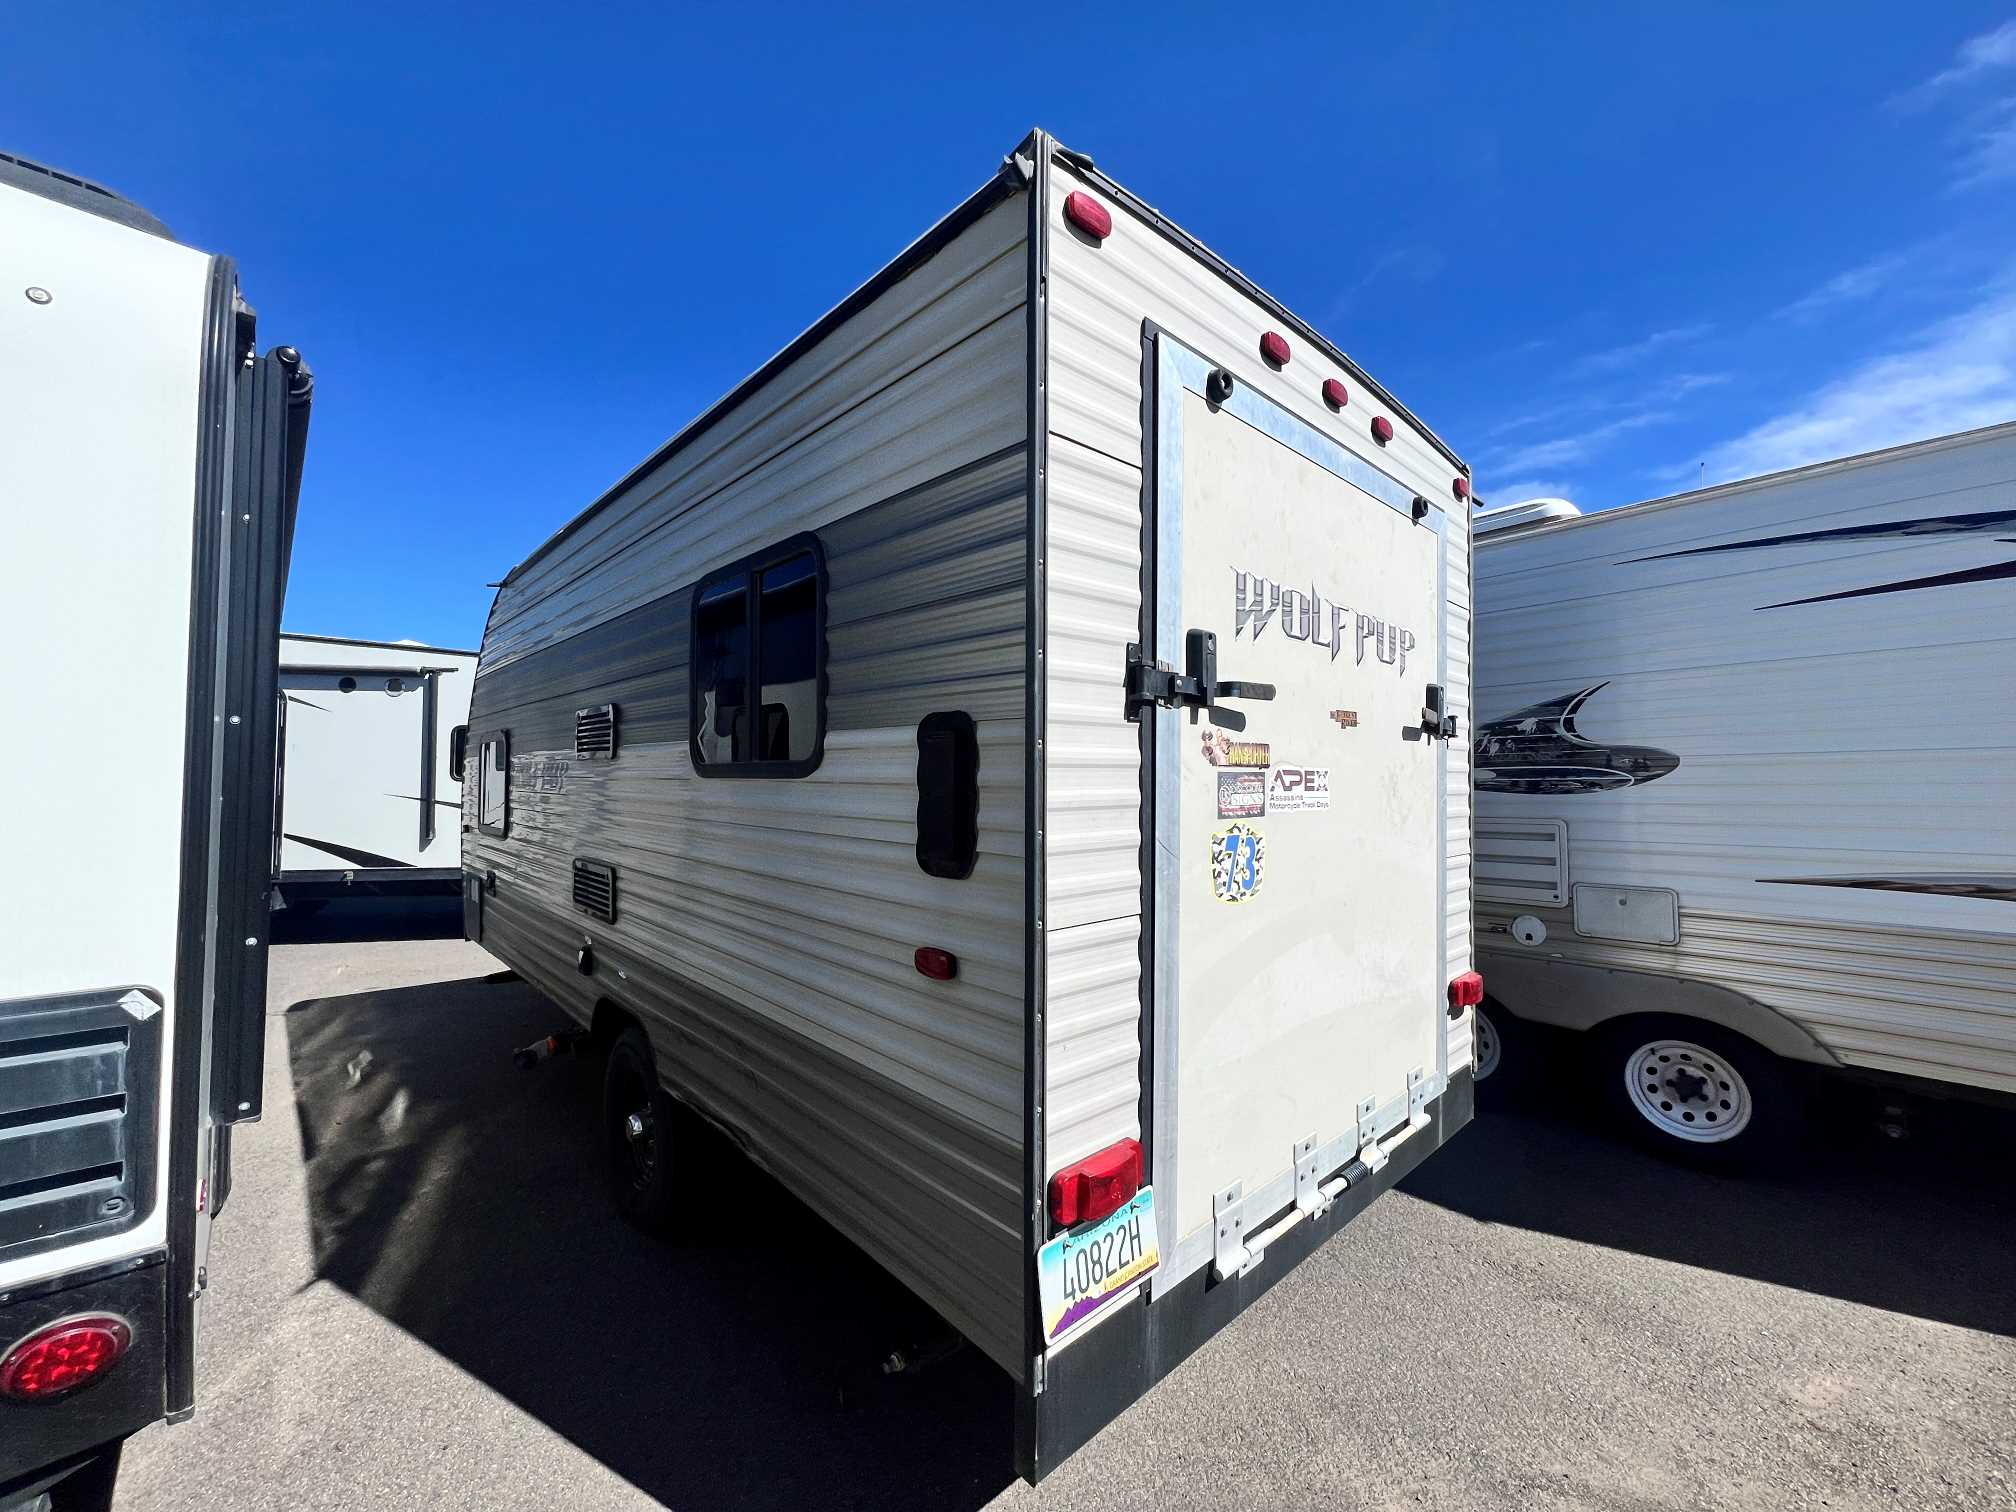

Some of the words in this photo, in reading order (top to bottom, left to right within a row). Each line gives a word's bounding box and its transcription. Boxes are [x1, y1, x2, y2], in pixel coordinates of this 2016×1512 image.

[1230, 565, 1349, 663] WOLF
[1351, 607, 1415, 677] PUP
[1270, 769, 1328, 791] APEX
[1225, 834, 1256, 892] 73
[1063, 1215, 1143, 1301] 40822H
